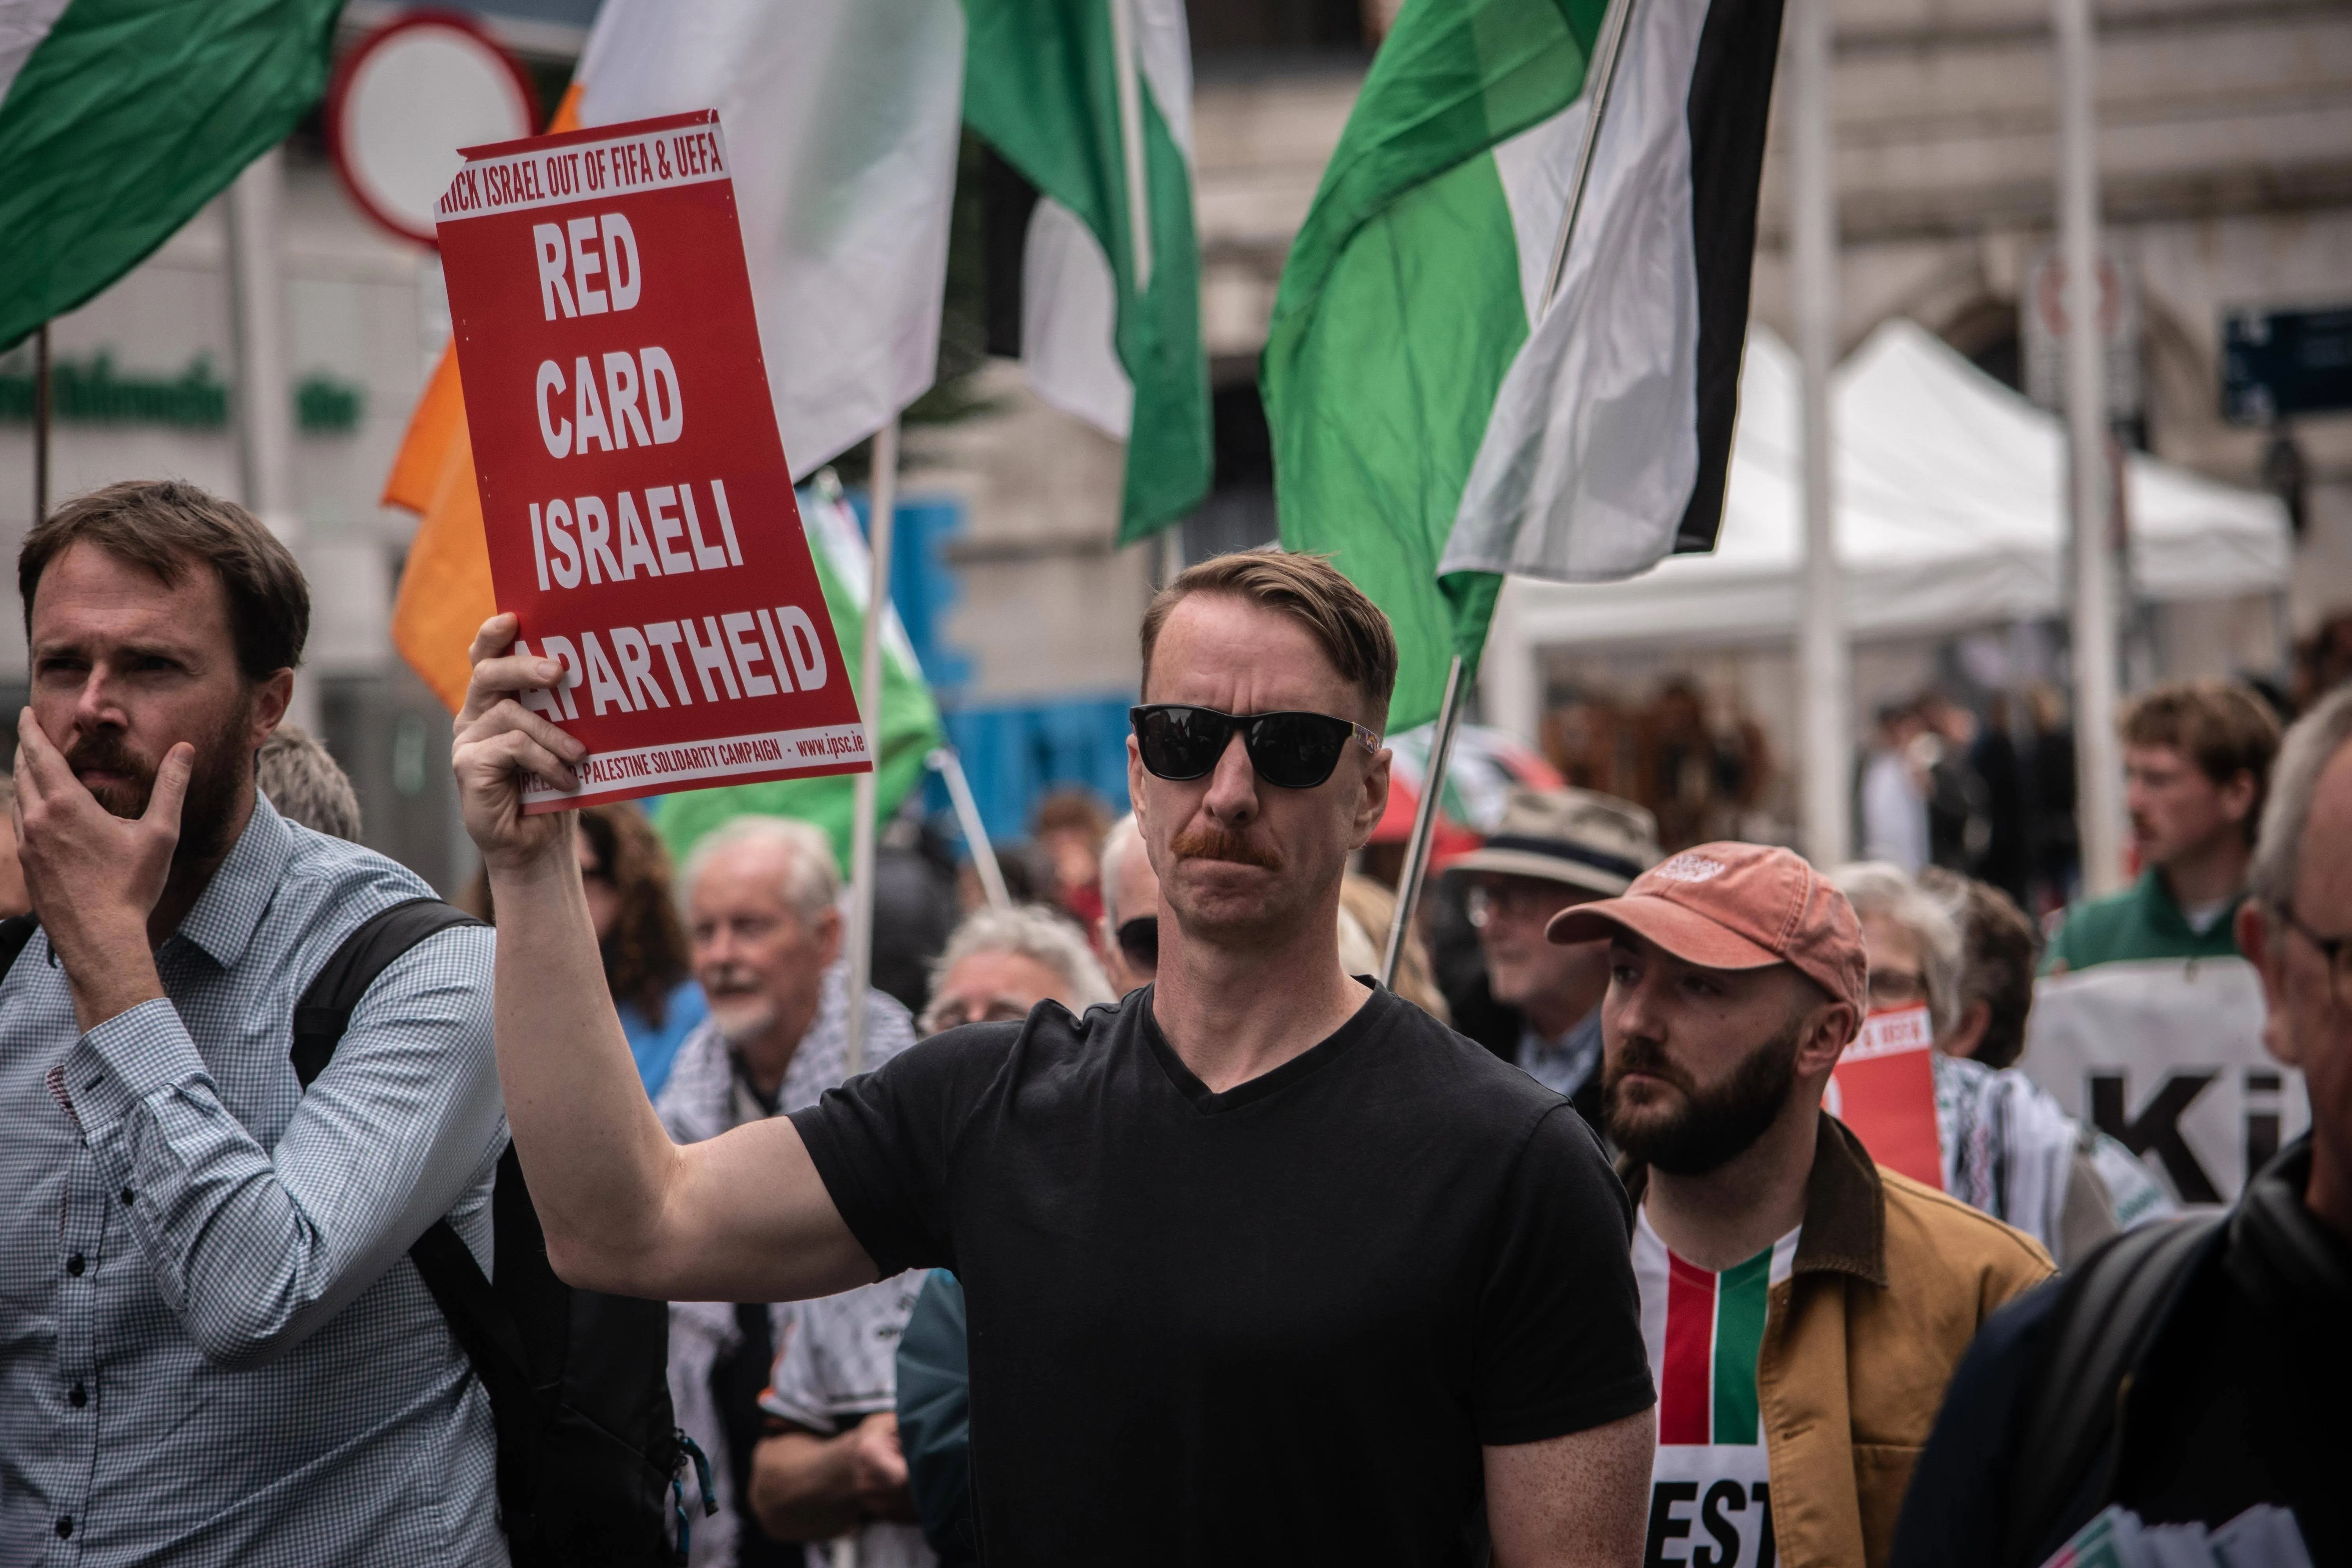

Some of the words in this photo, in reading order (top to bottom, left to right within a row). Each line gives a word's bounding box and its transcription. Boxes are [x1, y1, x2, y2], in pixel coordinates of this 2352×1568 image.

[482, 160, 545, 207] ISRAEL
[546, 153, 580, 197] OUT
[584, 149, 606, 192] OF
[611, 142, 654, 187] FIFA
[655, 140, 673, 180] &
[673, 132, 723, 178] UEFA
[533, 213, 641, 321] RED
[536, 346, 684, 459] CARD
[529, 479, 744, 591] ISRAELI
[651, 746, 719, 774] SOLIDARITY
[719, 739, 782, 766] CAMPAIGN
[795, 730, 865, 759] www.ipsc.ie
[2089, 1073, 2282, 1203] Ki
